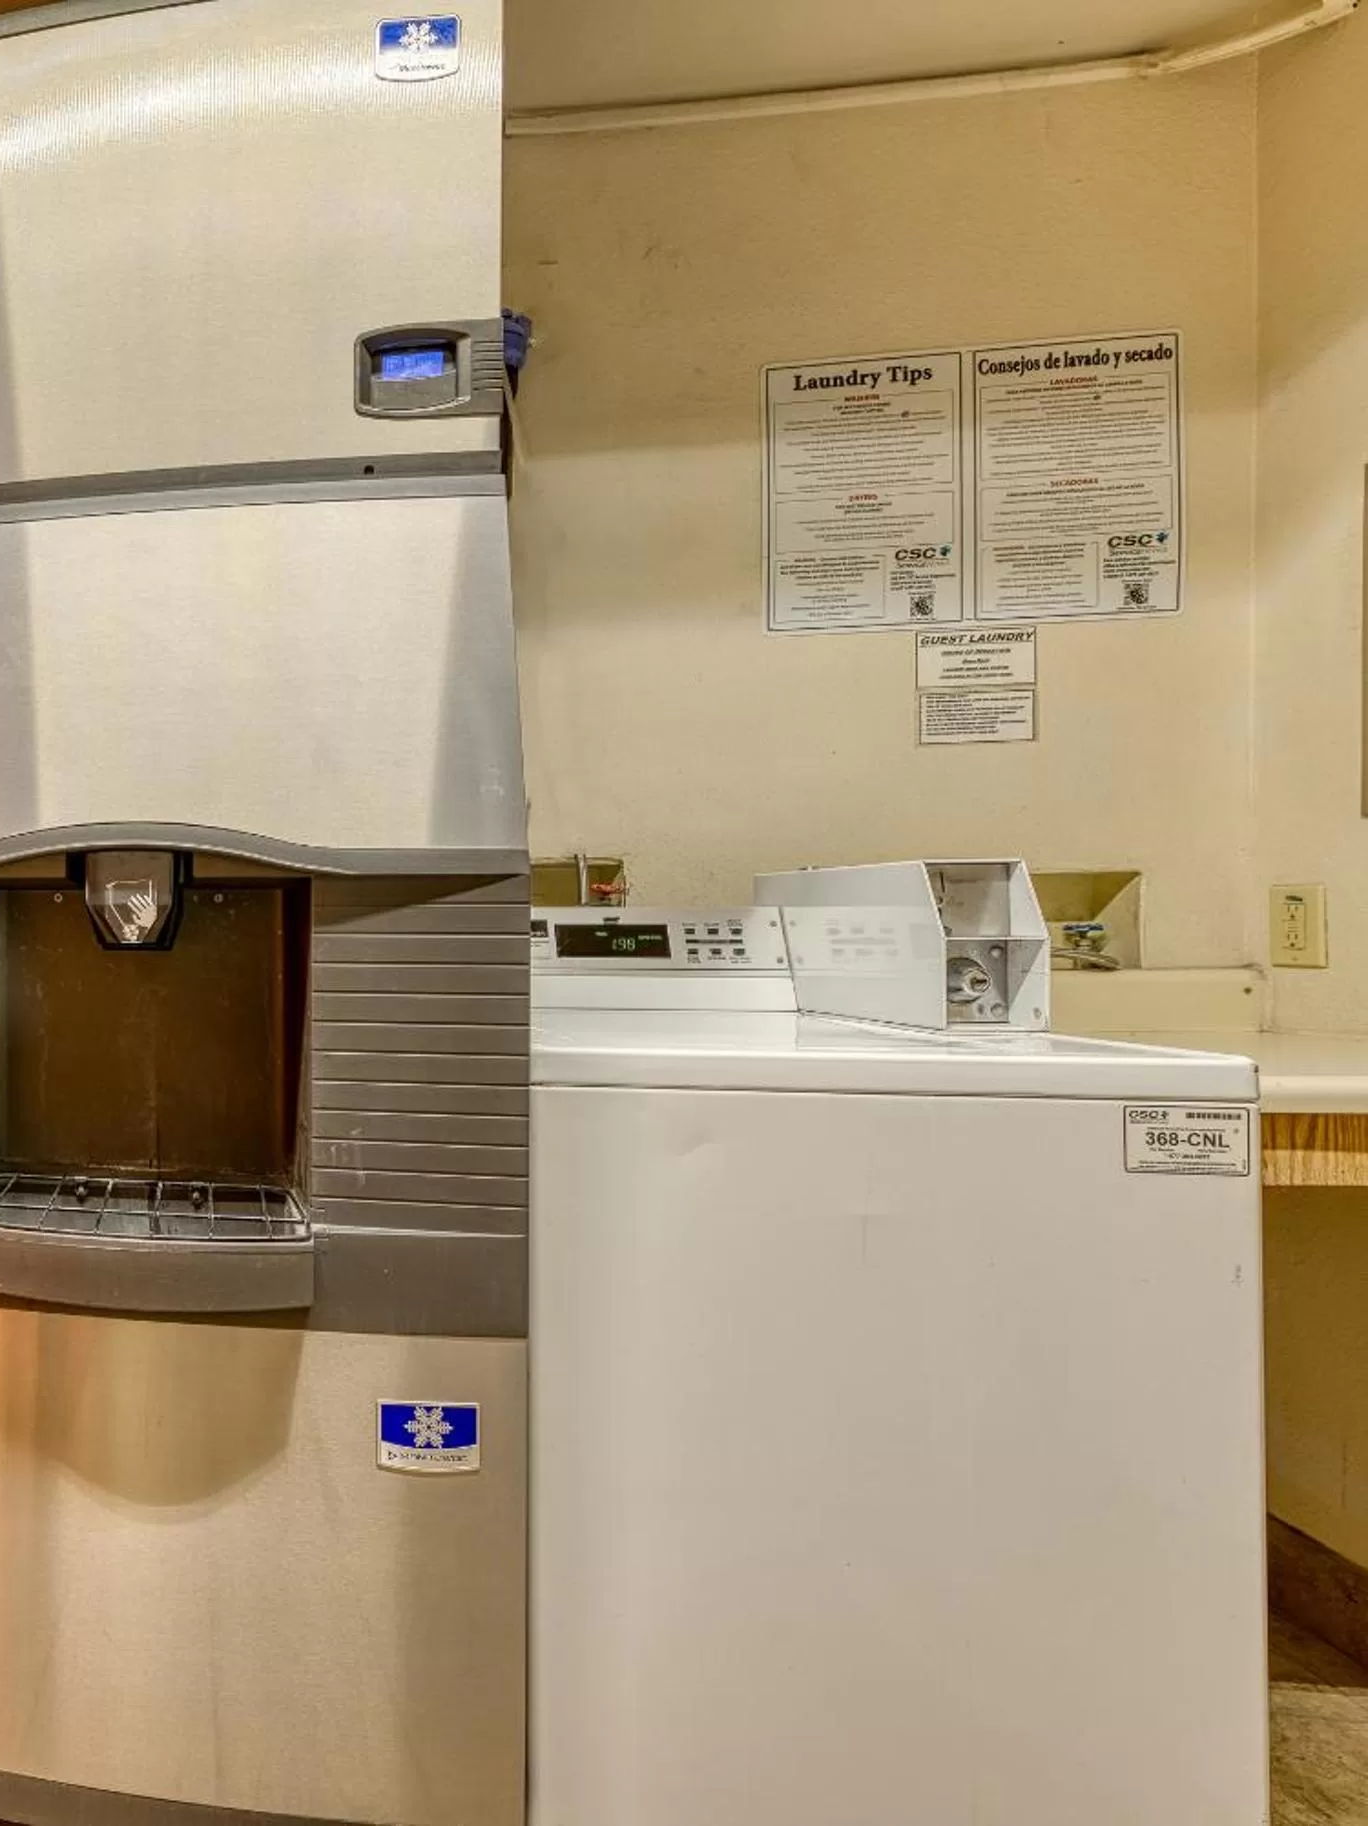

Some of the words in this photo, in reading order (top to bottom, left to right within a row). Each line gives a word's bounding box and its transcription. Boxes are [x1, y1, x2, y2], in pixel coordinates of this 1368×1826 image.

[978, 355, 1040, 377] Consejos
[1044, 352, 1061, 369] de
[1063, 348, 1110, 368] lavado
[1113, 351, 1122, 369] y
[1125, 343, 1173, 363] secado
[793, 369, 881, 391] Laundry
[887, 366, 933, 385] Tips
[1108, 534, 1153, 549] CSC
[895, 547, 936, 561] CSC
[969, 632, 1033, 643] LAUNDRY
[1145, 1131, 1230, 1148] 368-CNL
